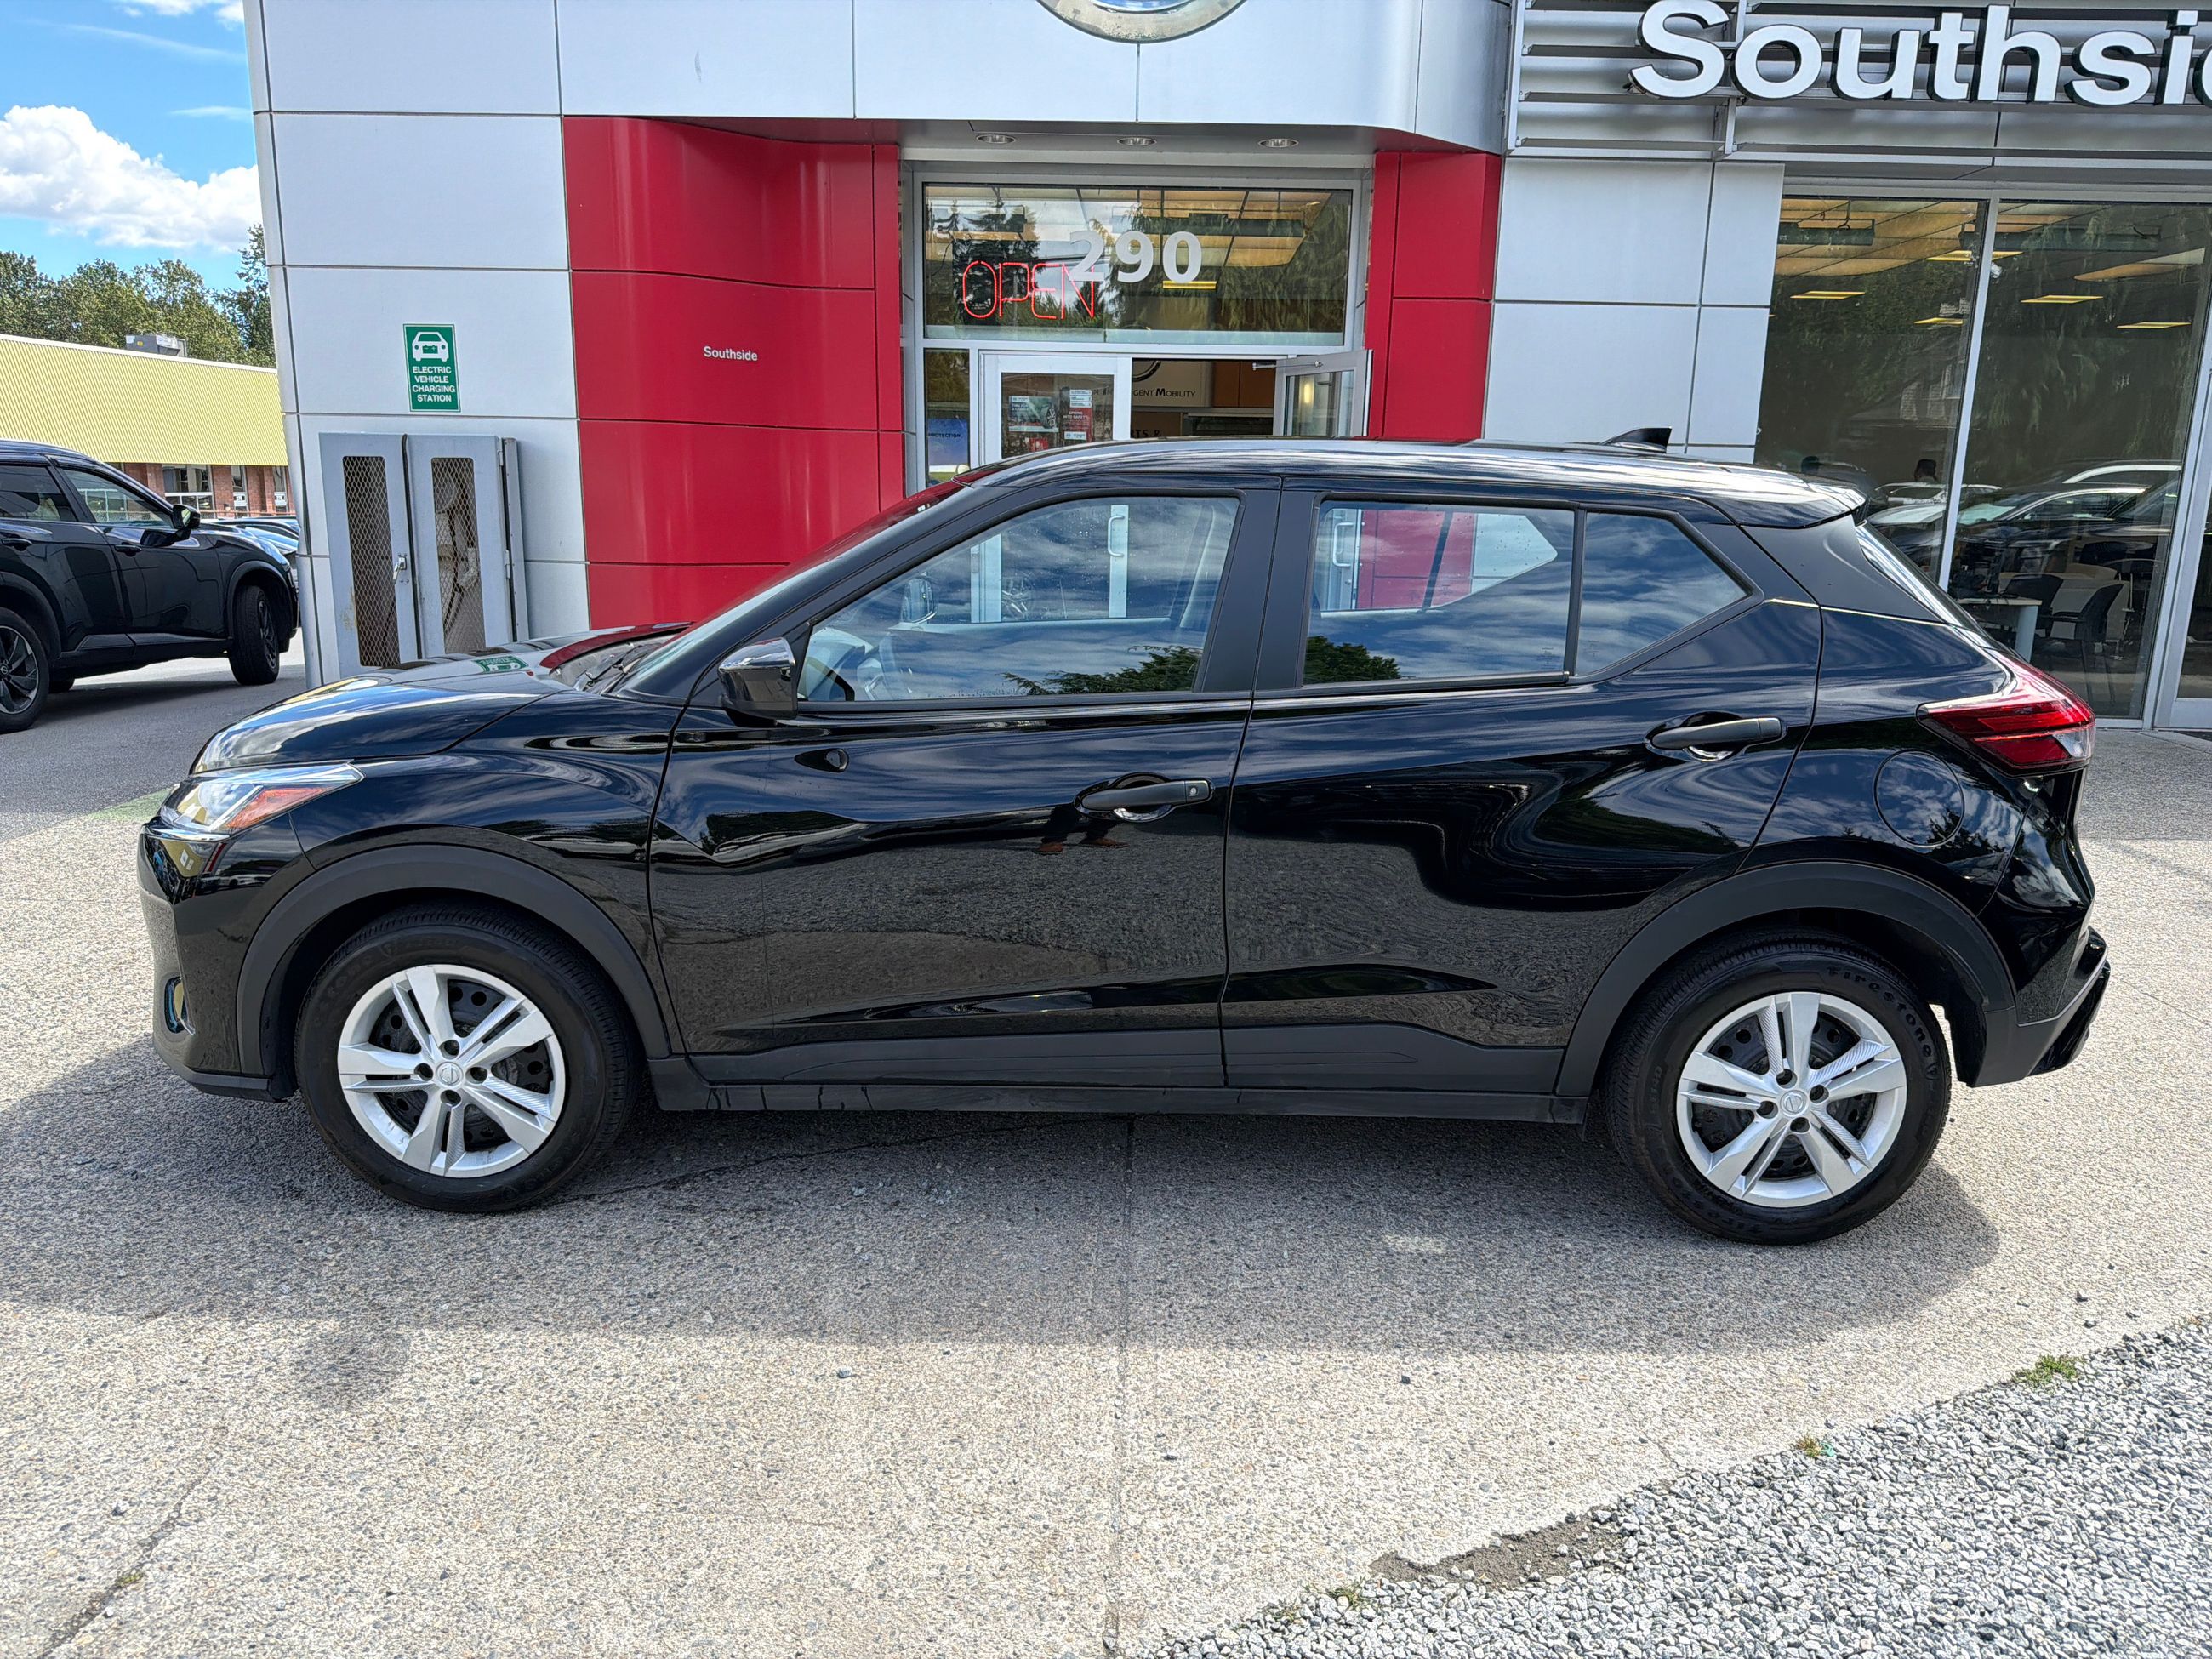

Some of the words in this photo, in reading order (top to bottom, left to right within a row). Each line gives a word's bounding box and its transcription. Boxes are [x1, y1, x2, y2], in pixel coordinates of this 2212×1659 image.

[1628, 0, 2212, 107] Southsi
[1069, 231, 1202, 283] 290
[962, 260, 1095, 319] OPEN
[703, 345, 758, 362] Southside
[412, 366, 452, 374] ELECTRIC
[414, 375, 449, 384] VEHICLE
[412, 385, 456, 393] CHARGING
[417, 394, 453, 402] STATION
